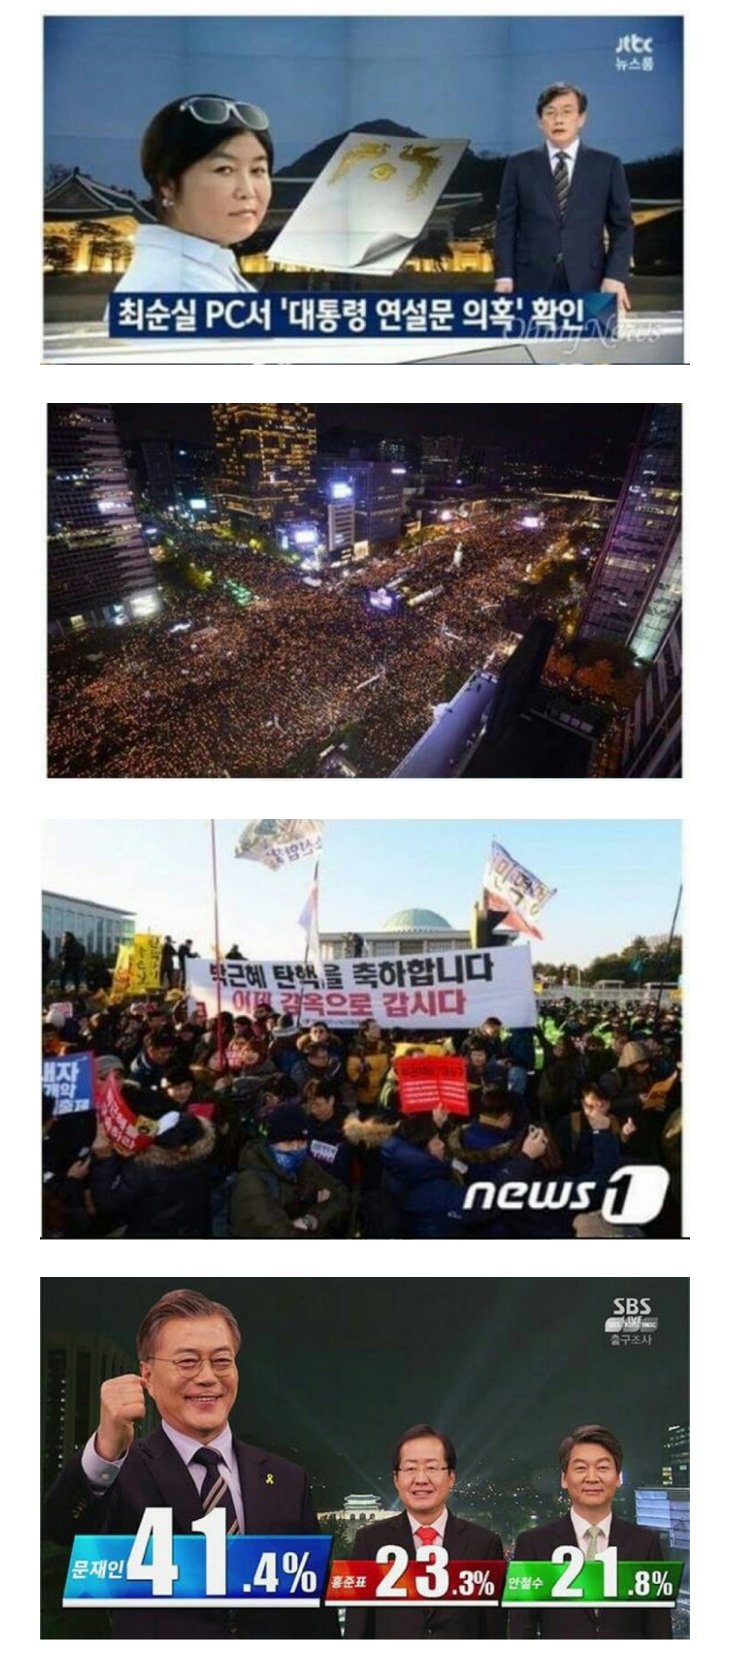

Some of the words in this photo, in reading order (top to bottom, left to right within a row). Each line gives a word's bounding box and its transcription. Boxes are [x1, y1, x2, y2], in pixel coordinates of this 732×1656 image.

[210, 963, 268, 990] 박근혜
[353, 951, 494, 989] 축하합니다
[280, 989, 374, 1017] 감옥으로
[383, 988, 467, 1017] 갑시다
